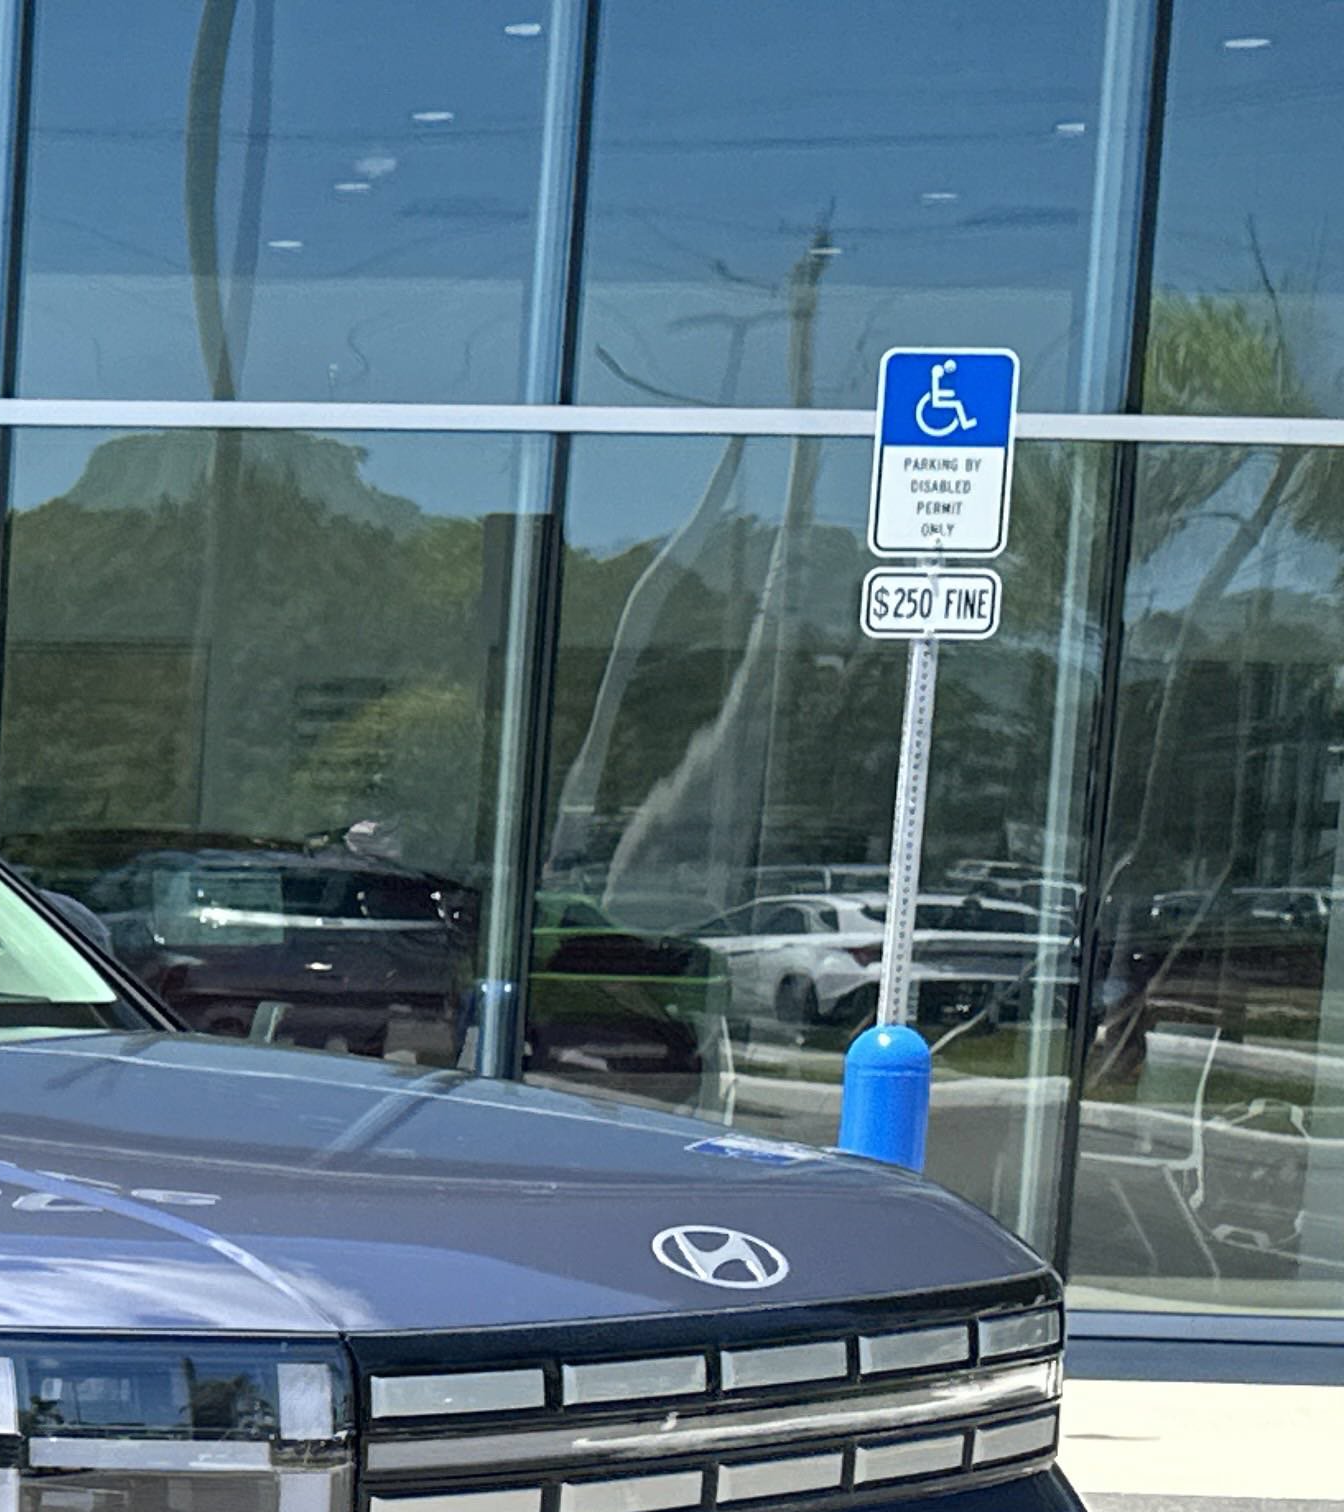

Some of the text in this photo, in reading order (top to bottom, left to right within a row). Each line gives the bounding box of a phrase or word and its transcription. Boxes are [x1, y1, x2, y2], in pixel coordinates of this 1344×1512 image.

[903, 457, 982, 472] PARKING BY
[910, 478, 972, 494] DISABLED
[916, 501, 963, 515] PERMIT
[920, 522, 955, 537] ONLY
[873, 585, 989, 619] $250 FINE
